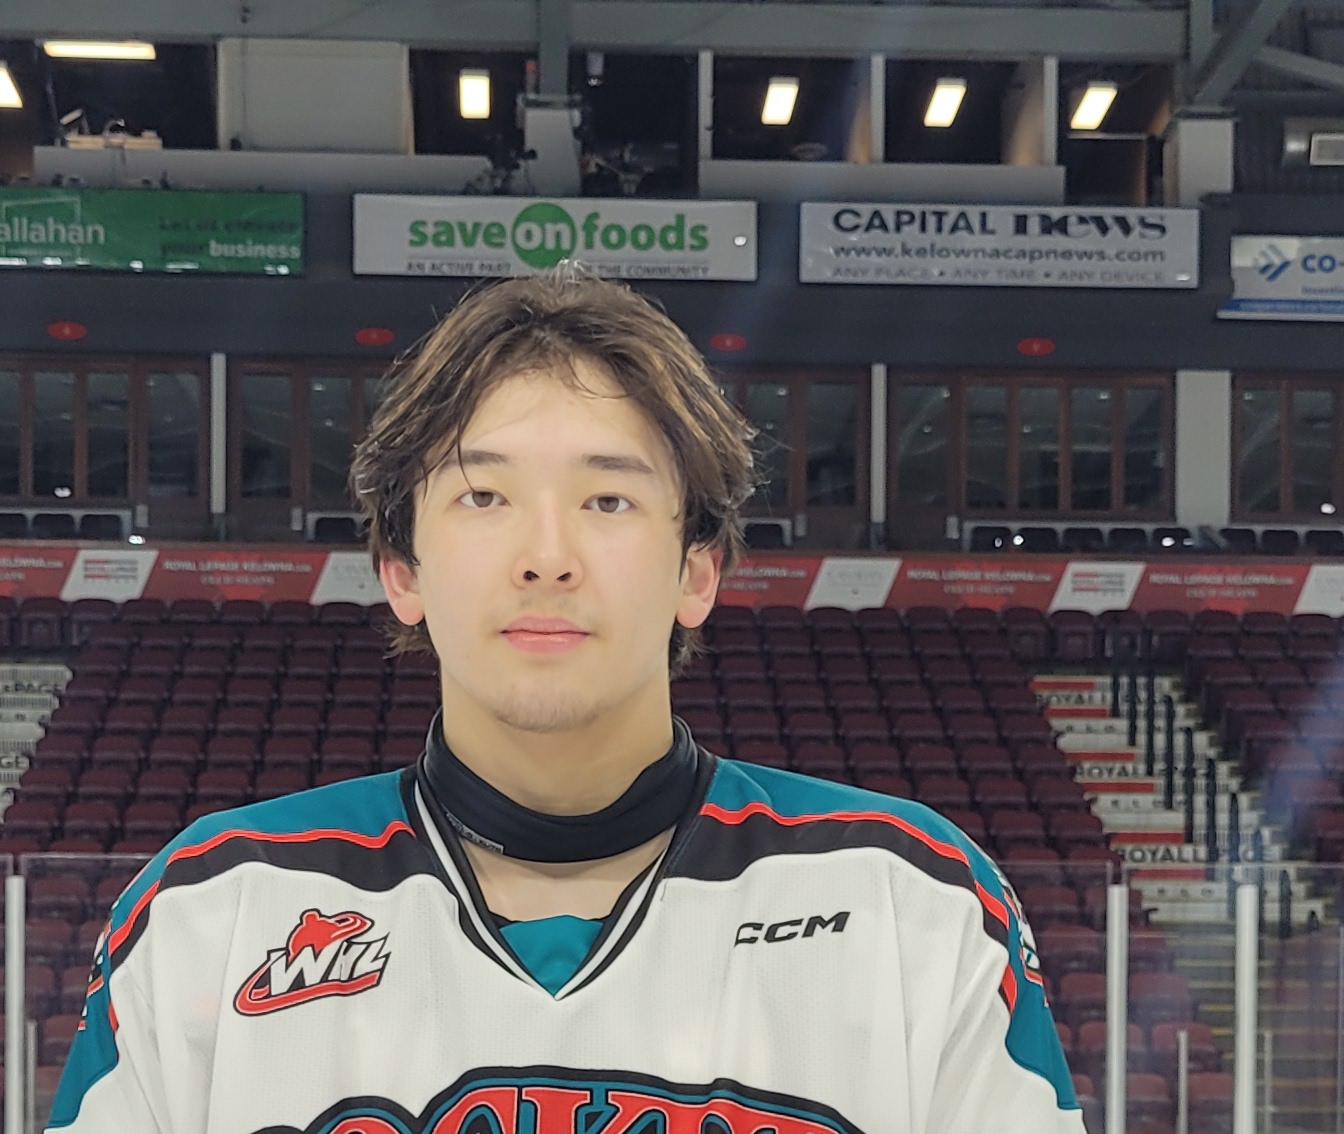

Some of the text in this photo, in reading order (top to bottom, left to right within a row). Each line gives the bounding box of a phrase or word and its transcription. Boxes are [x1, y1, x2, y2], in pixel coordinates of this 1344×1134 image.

[833, 208, 1168, 240] CAPITAL news
[209, 239, 302, 259] business
[832, 243, 1166, 264] www.kelownacapnews.com
[734, 911, 851, 948] CCM
[267, 930, 392, 997] WHL
